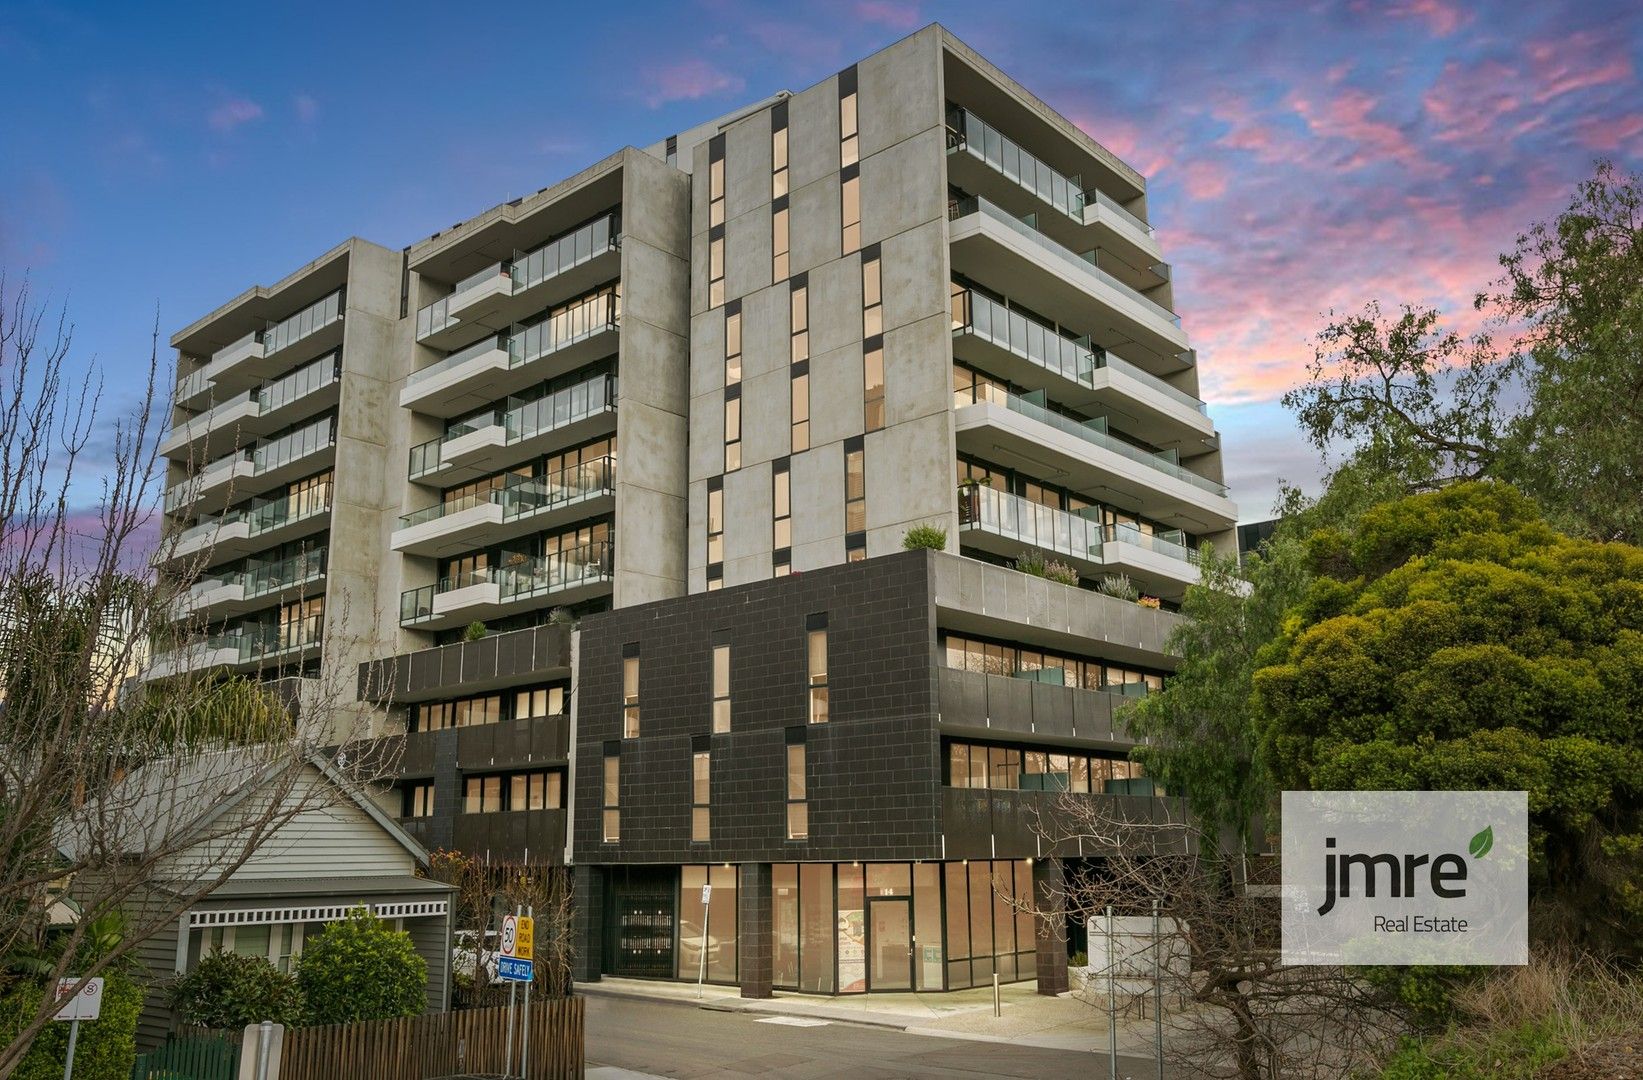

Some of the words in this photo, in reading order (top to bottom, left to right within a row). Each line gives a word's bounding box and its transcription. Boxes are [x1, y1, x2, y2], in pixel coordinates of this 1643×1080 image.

[504, 927, 514, 943] 50
[500, 962, 512, 974] DRIVE
[514, 964, 530, 976] SAFELY
